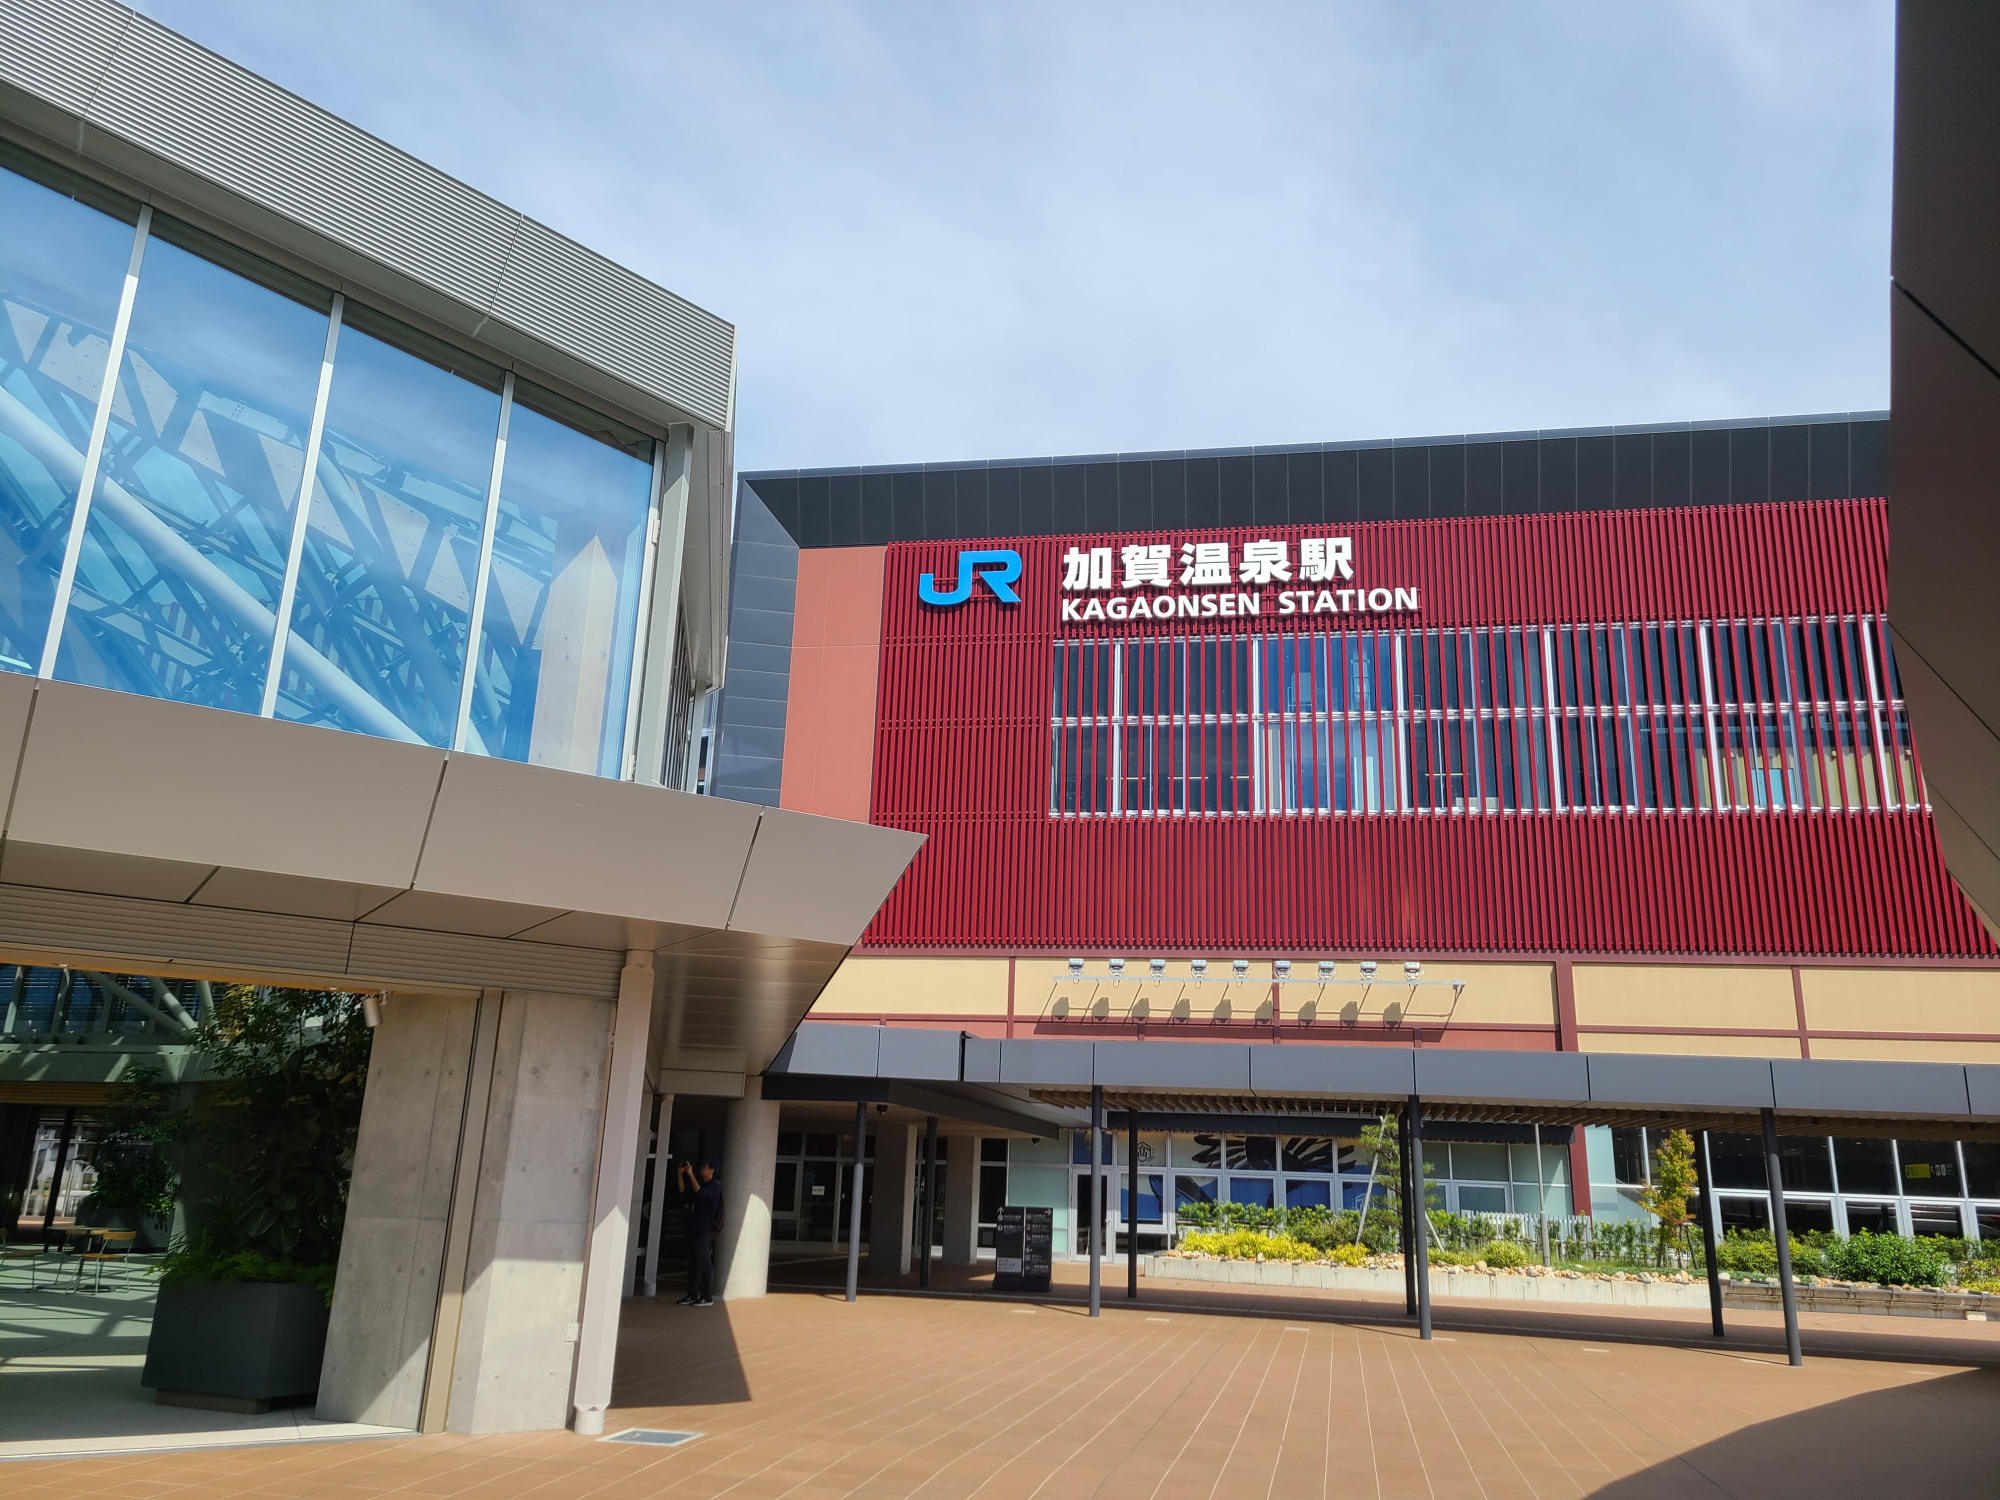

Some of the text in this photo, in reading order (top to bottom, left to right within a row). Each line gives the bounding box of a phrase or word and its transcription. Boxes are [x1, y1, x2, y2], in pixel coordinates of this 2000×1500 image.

[919, 550, 1022, 605] JR
[1062, 537, 1354, 590] 加賀温泉駅
[1062, 587, 1418, 621] KAGAONSEN STATION
